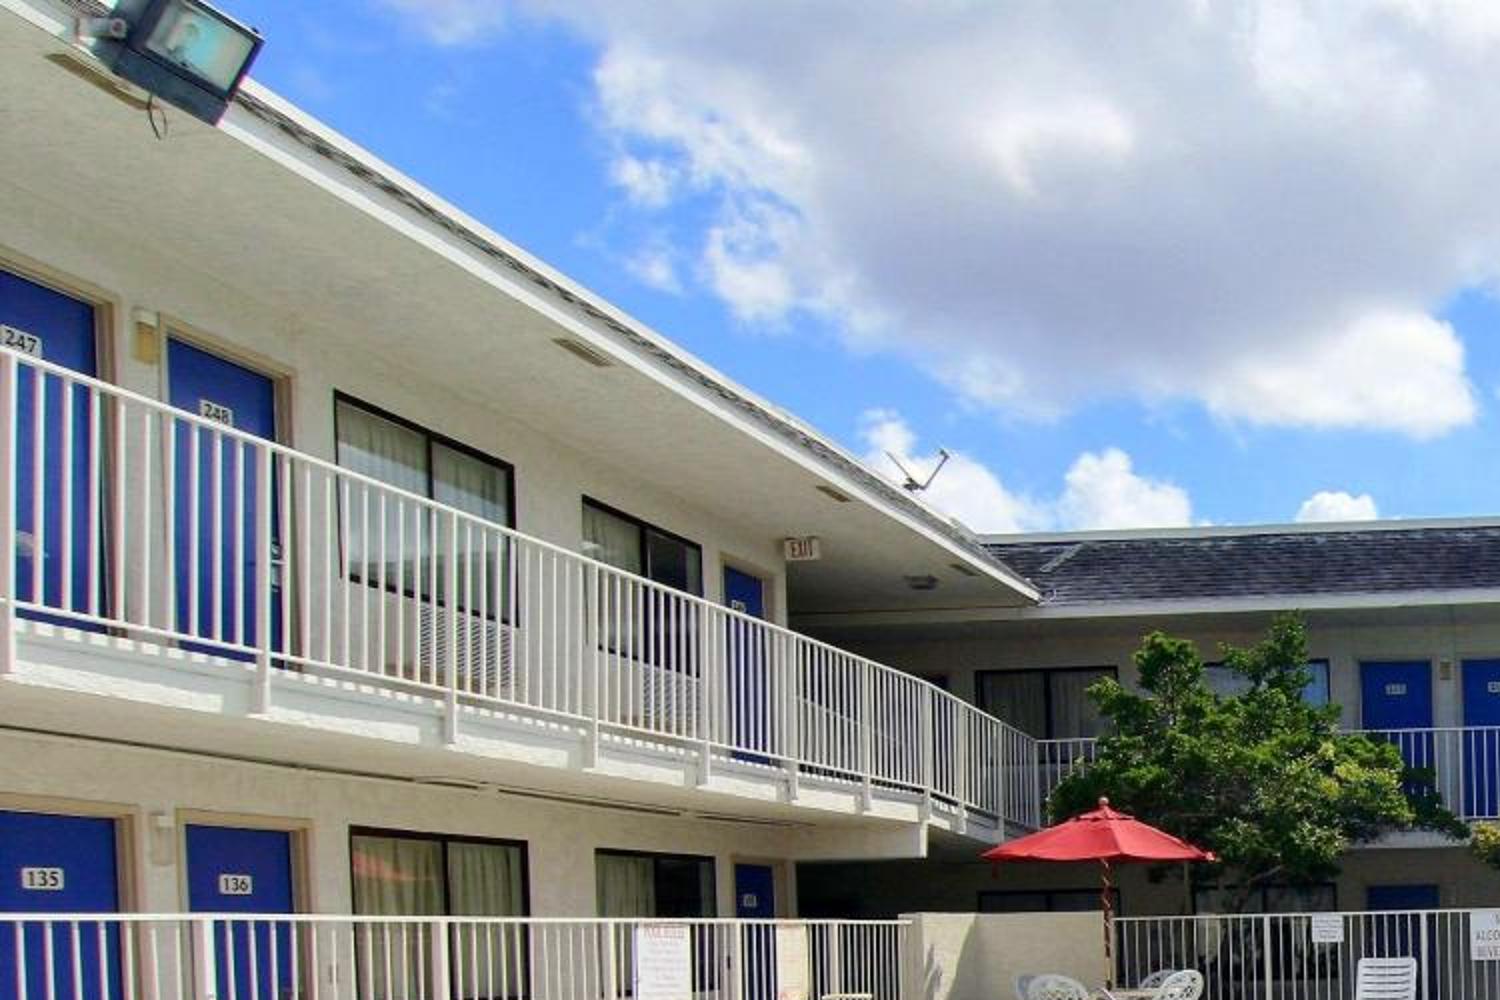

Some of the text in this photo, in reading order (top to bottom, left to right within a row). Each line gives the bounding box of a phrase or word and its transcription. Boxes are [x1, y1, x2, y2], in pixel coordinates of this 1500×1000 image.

[5, 329, 38, 353] 247
[203, 403, 229, 425] 248
[28, 871, 59, 887] 135
[223, 877, 248, 892] 136
